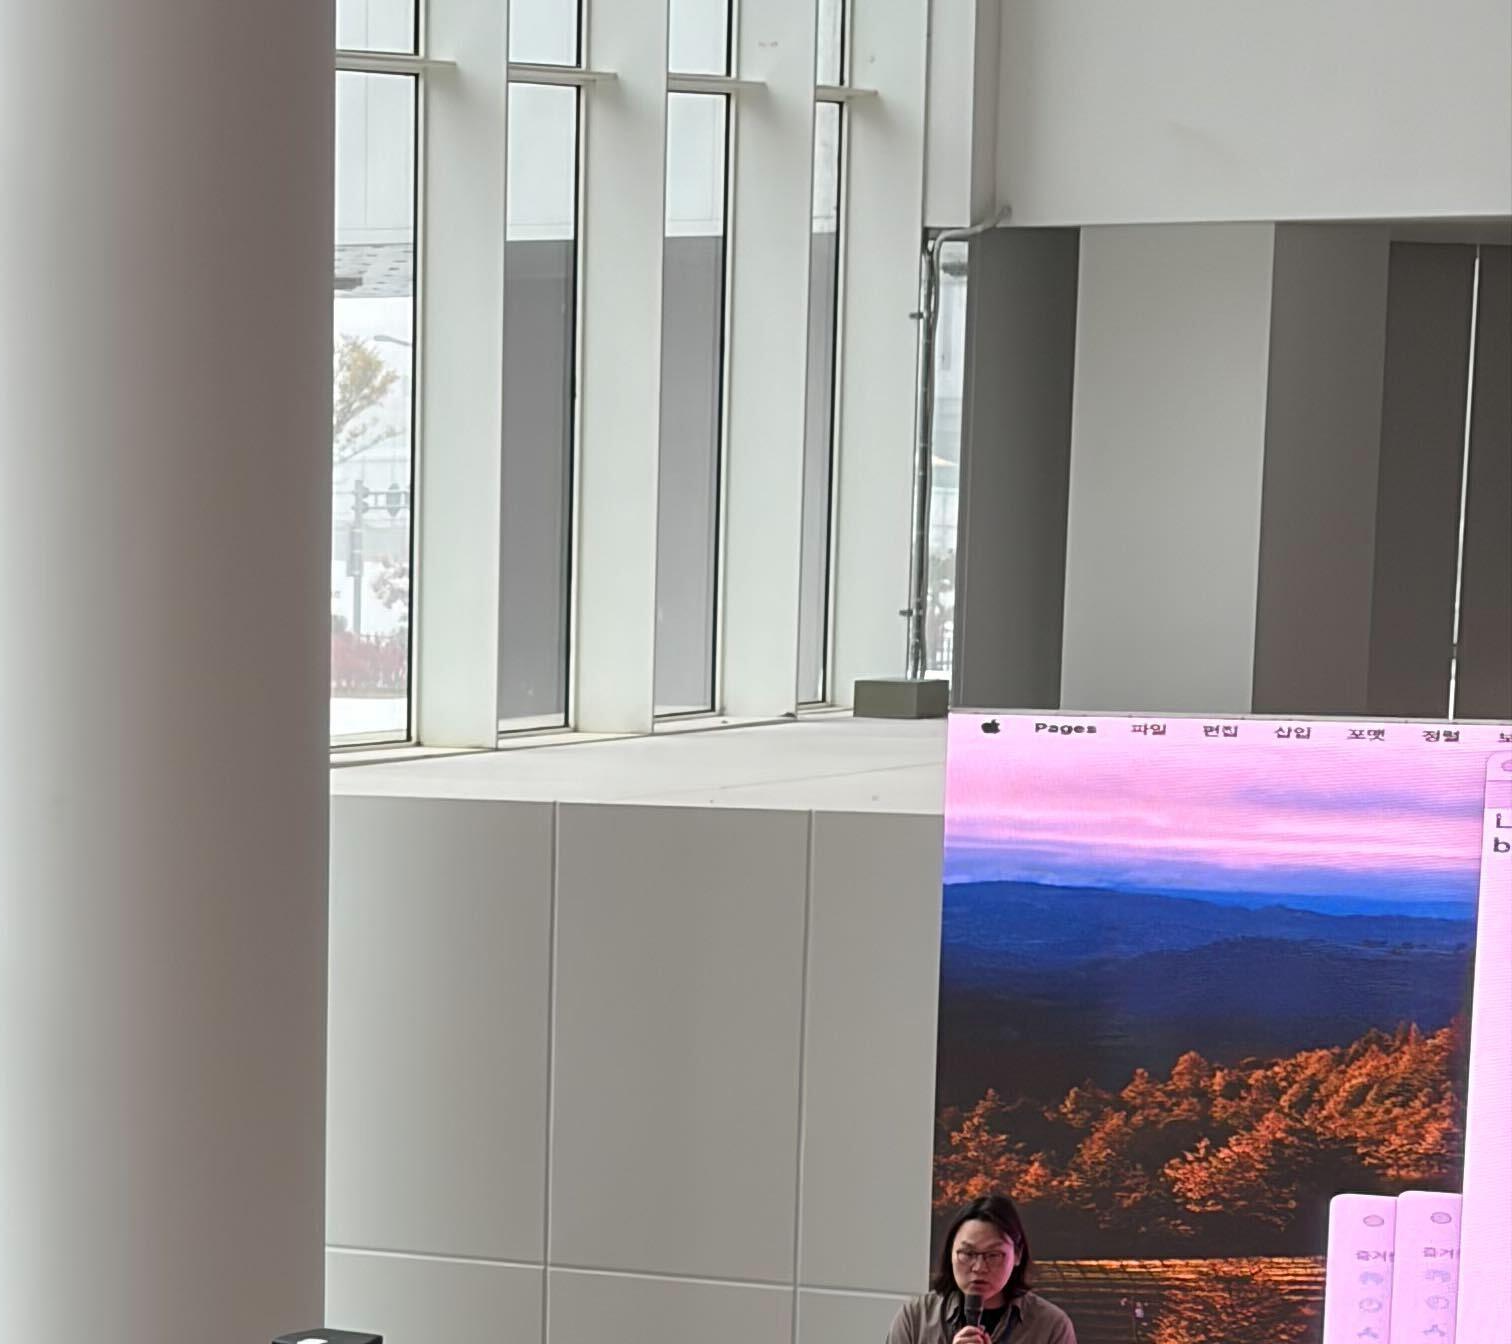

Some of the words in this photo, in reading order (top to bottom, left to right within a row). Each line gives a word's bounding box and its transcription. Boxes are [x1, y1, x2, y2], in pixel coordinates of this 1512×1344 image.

[1035, 723, 1097, 735] Pages
[1131, 724, 1167, 736] 파일
[1274, 726, 1311, 740] 삽입
[1422, 730, 1461, 743] 정렬
